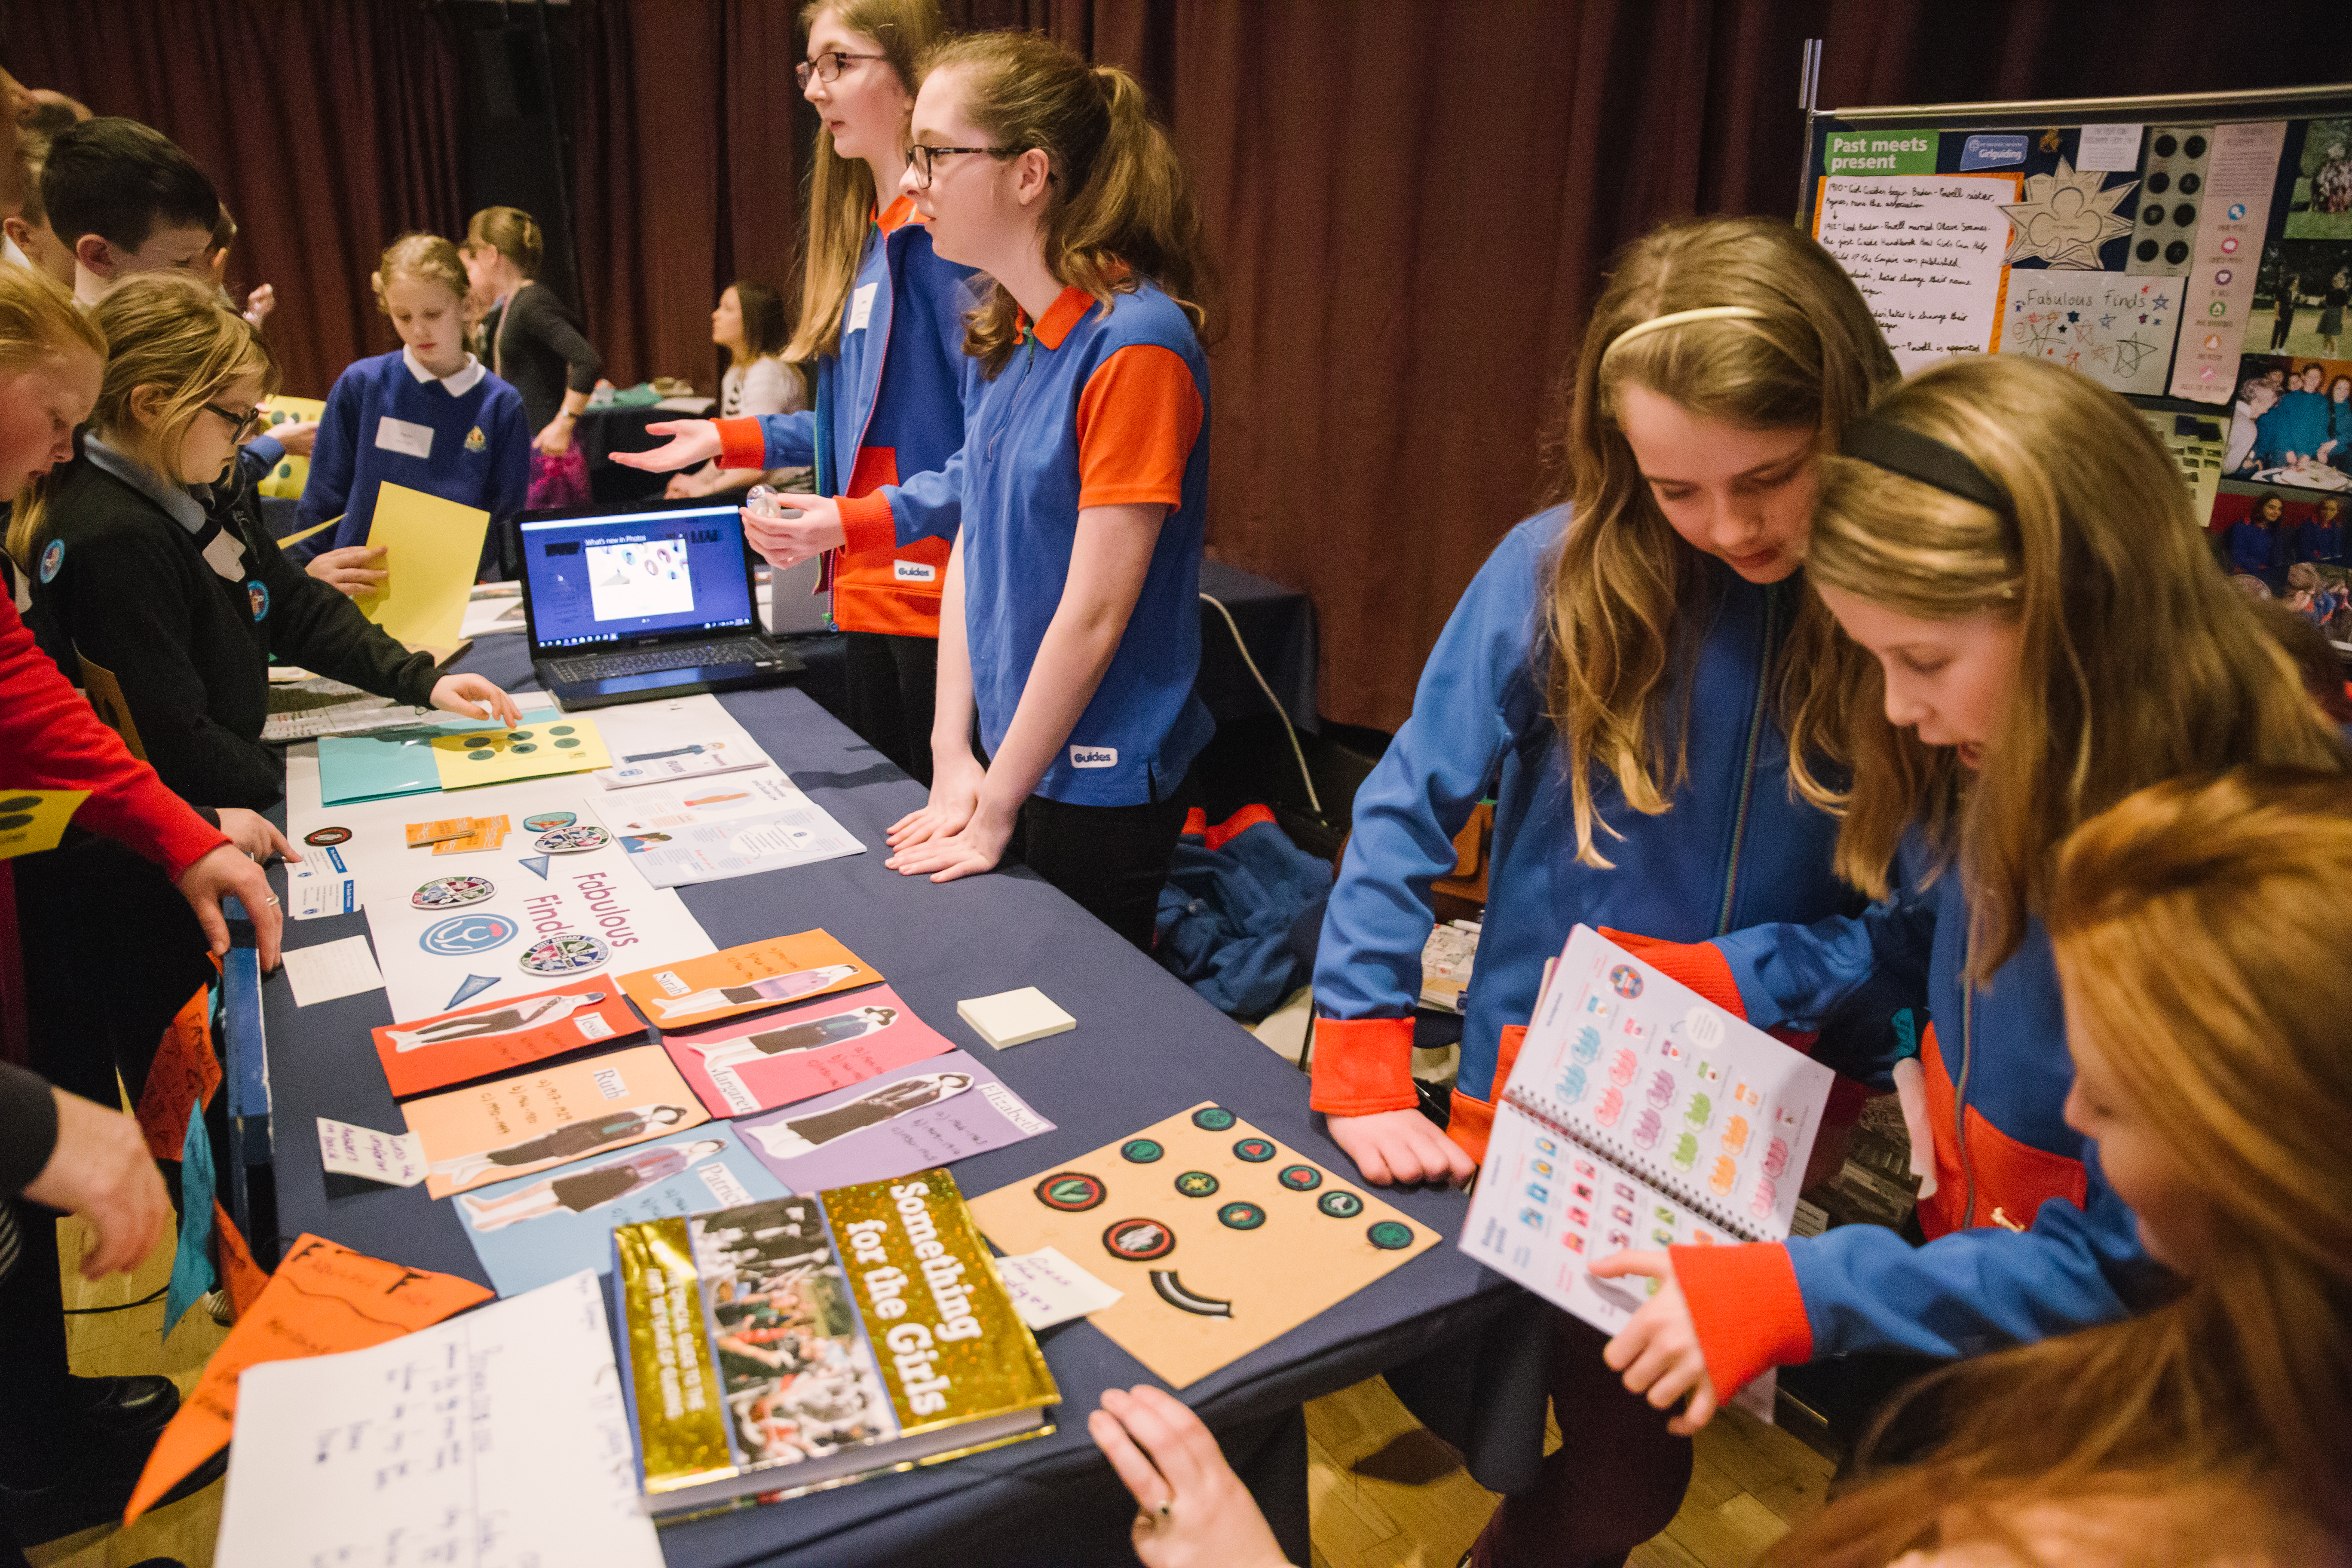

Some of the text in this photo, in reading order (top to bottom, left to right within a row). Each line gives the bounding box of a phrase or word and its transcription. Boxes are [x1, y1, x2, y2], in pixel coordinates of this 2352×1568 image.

[1834, 138, 1928, 153] Past meets
[1979, 148, 2021, 160] Girlguiding
[1831, 156, 1896, 172] present
[1972, 241, 1988, 254] Help
[2026, 289, 2145, 308] Fabulous Finds
[626, 535, 646, 543] Photos
[898, 567, 929, 578] Guides
[1074, 751, 1111, 764] Guides
[572, 872, 639, 947] Fabulous
[655, 972, 688, 995] Sarah
[594, 1069, 626, 1100] Ruth
[983, 1085, 1040, 1133] Elizabeth
[698, 1163, 752, 1205] Patrici
[889, 1181, 983, 1343] Something
[846, 1219, 951, 1416] for the Girls
[660, 1366, 684, 1420] GUIDING
